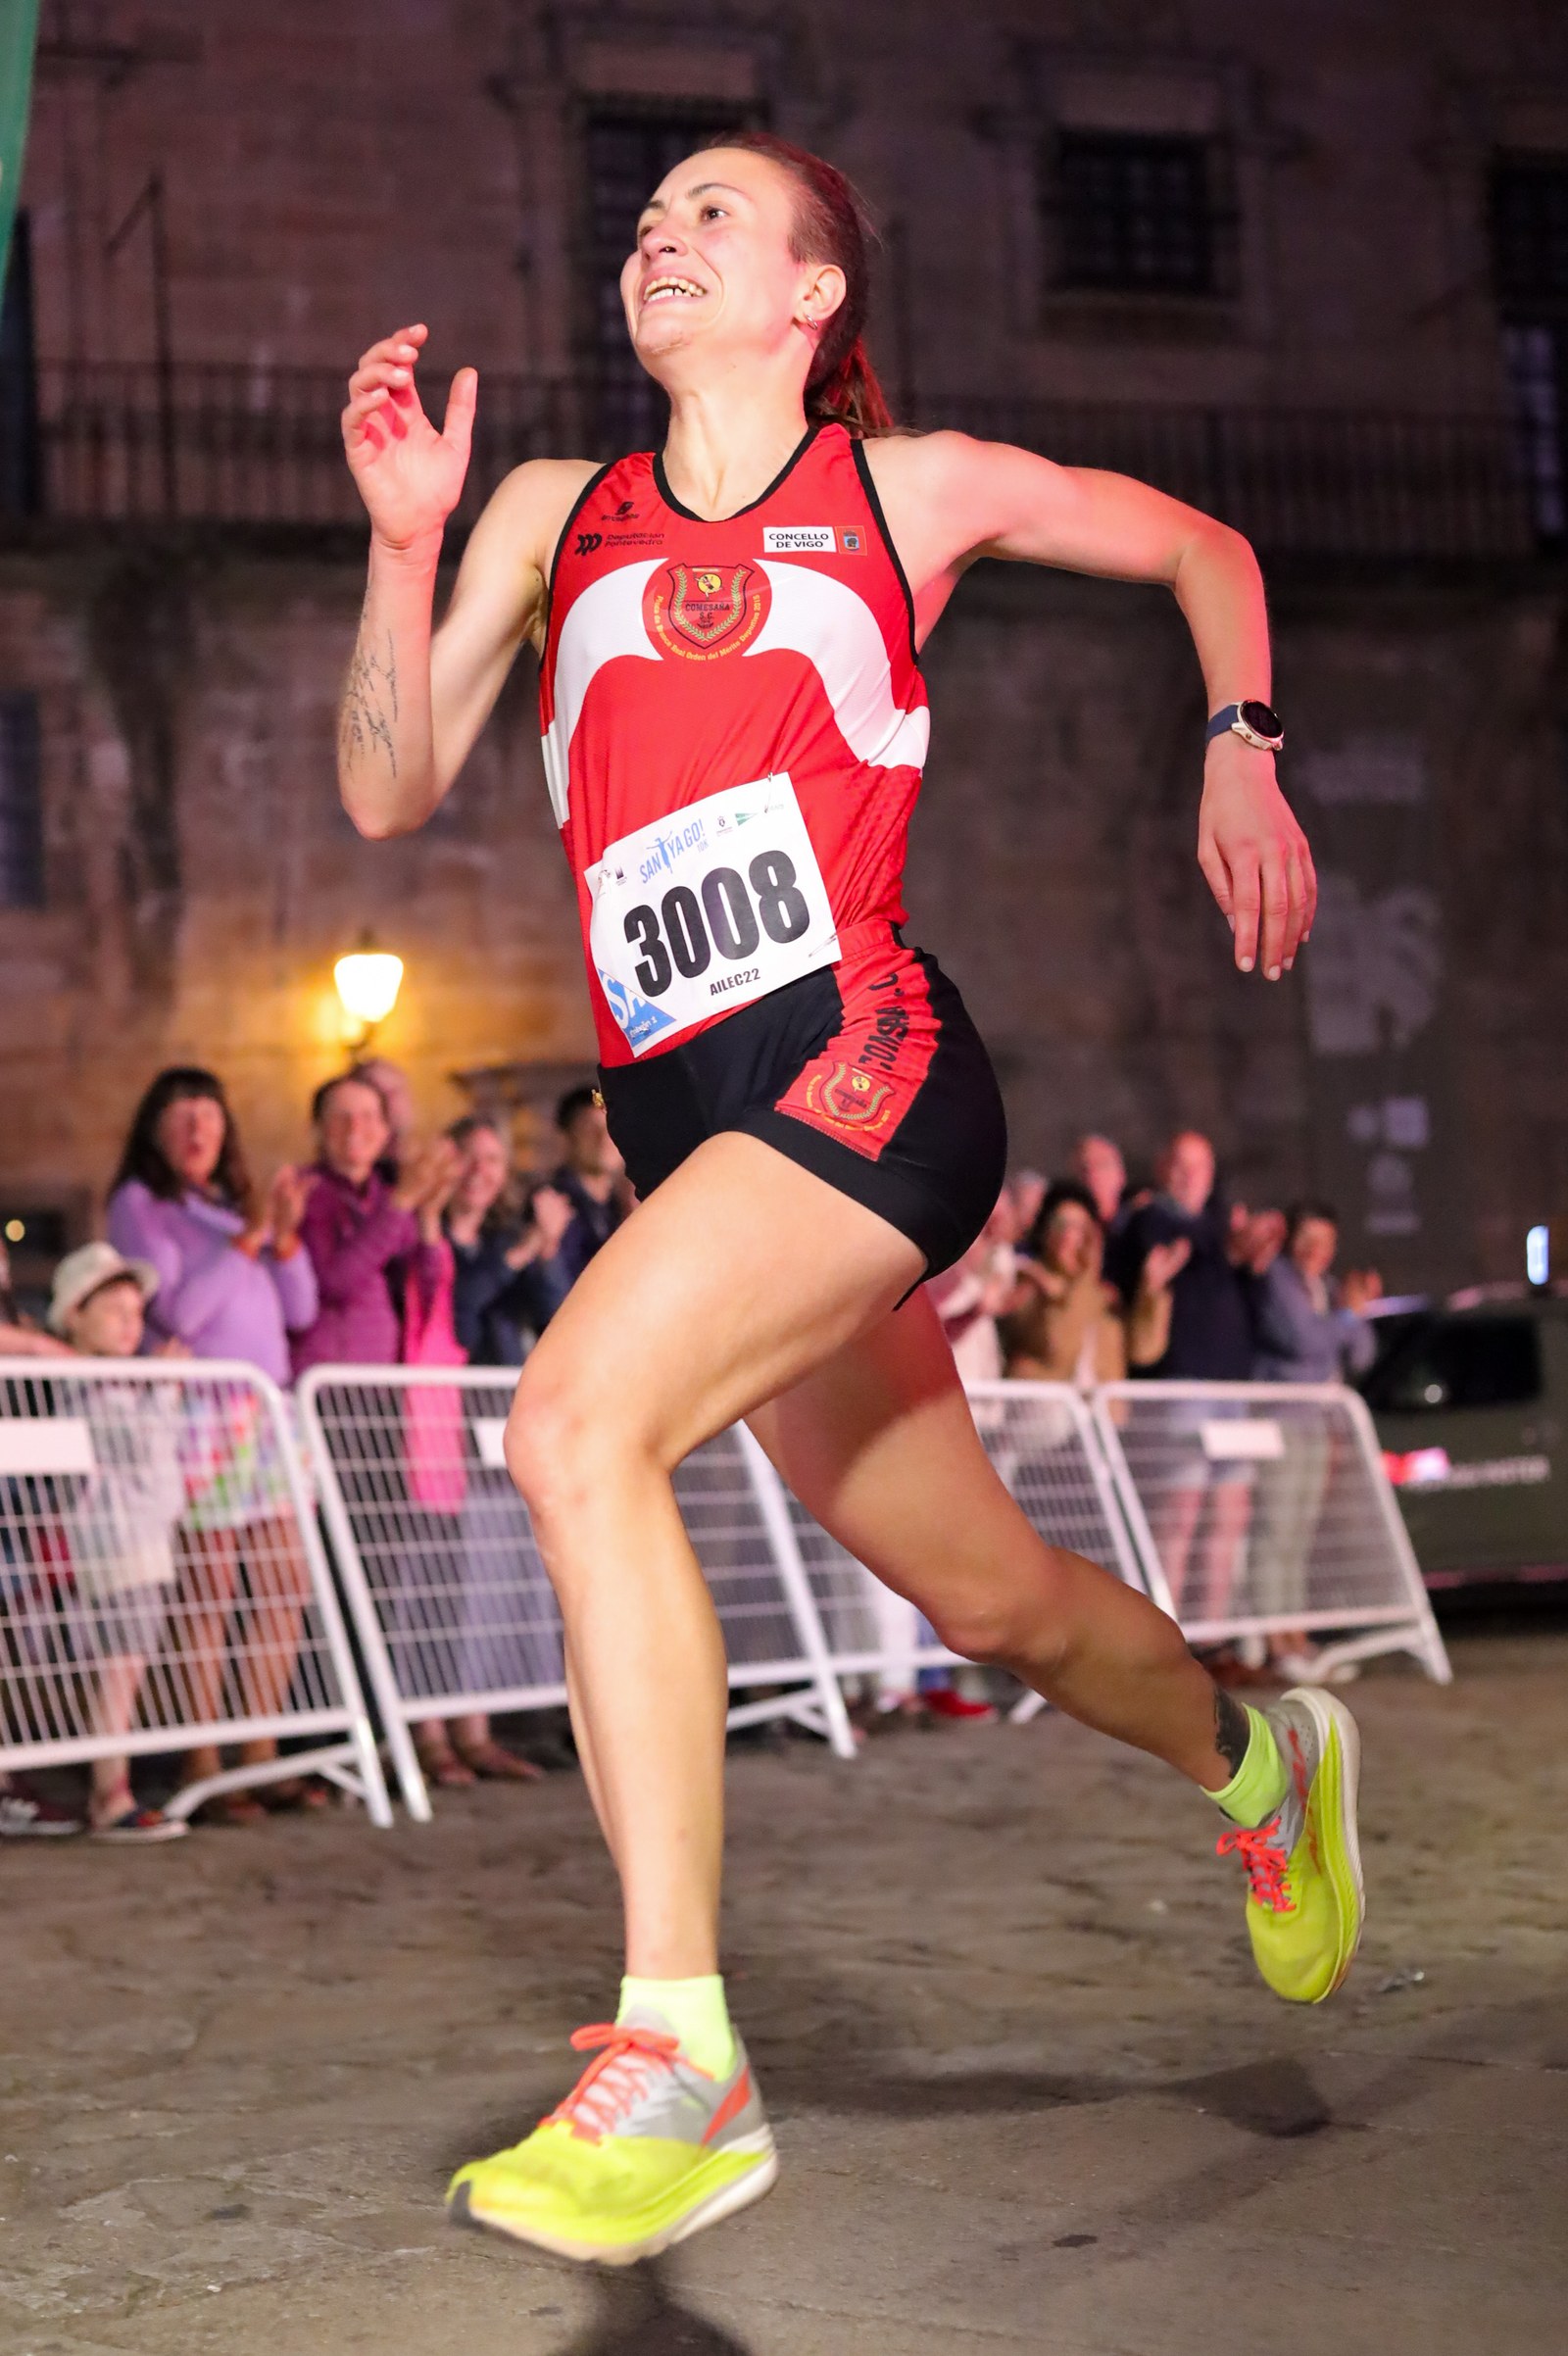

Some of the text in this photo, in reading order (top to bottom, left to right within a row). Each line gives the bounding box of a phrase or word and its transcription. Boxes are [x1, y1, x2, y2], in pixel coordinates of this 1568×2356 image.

[653, 614, 661, 624] de
[670, 644, 686, 658] Real
[685, 651, 707, 662] Orden
[707, 651, 719, 661] del
[739, 612, 760, 642] Deportivo
[752, 594, 761, 612] 2015
[685, 602, 730, 612] COMESAÑA
[623, 850, 810, 998] 3008
[710, 967, 761, 996] AILEC22
